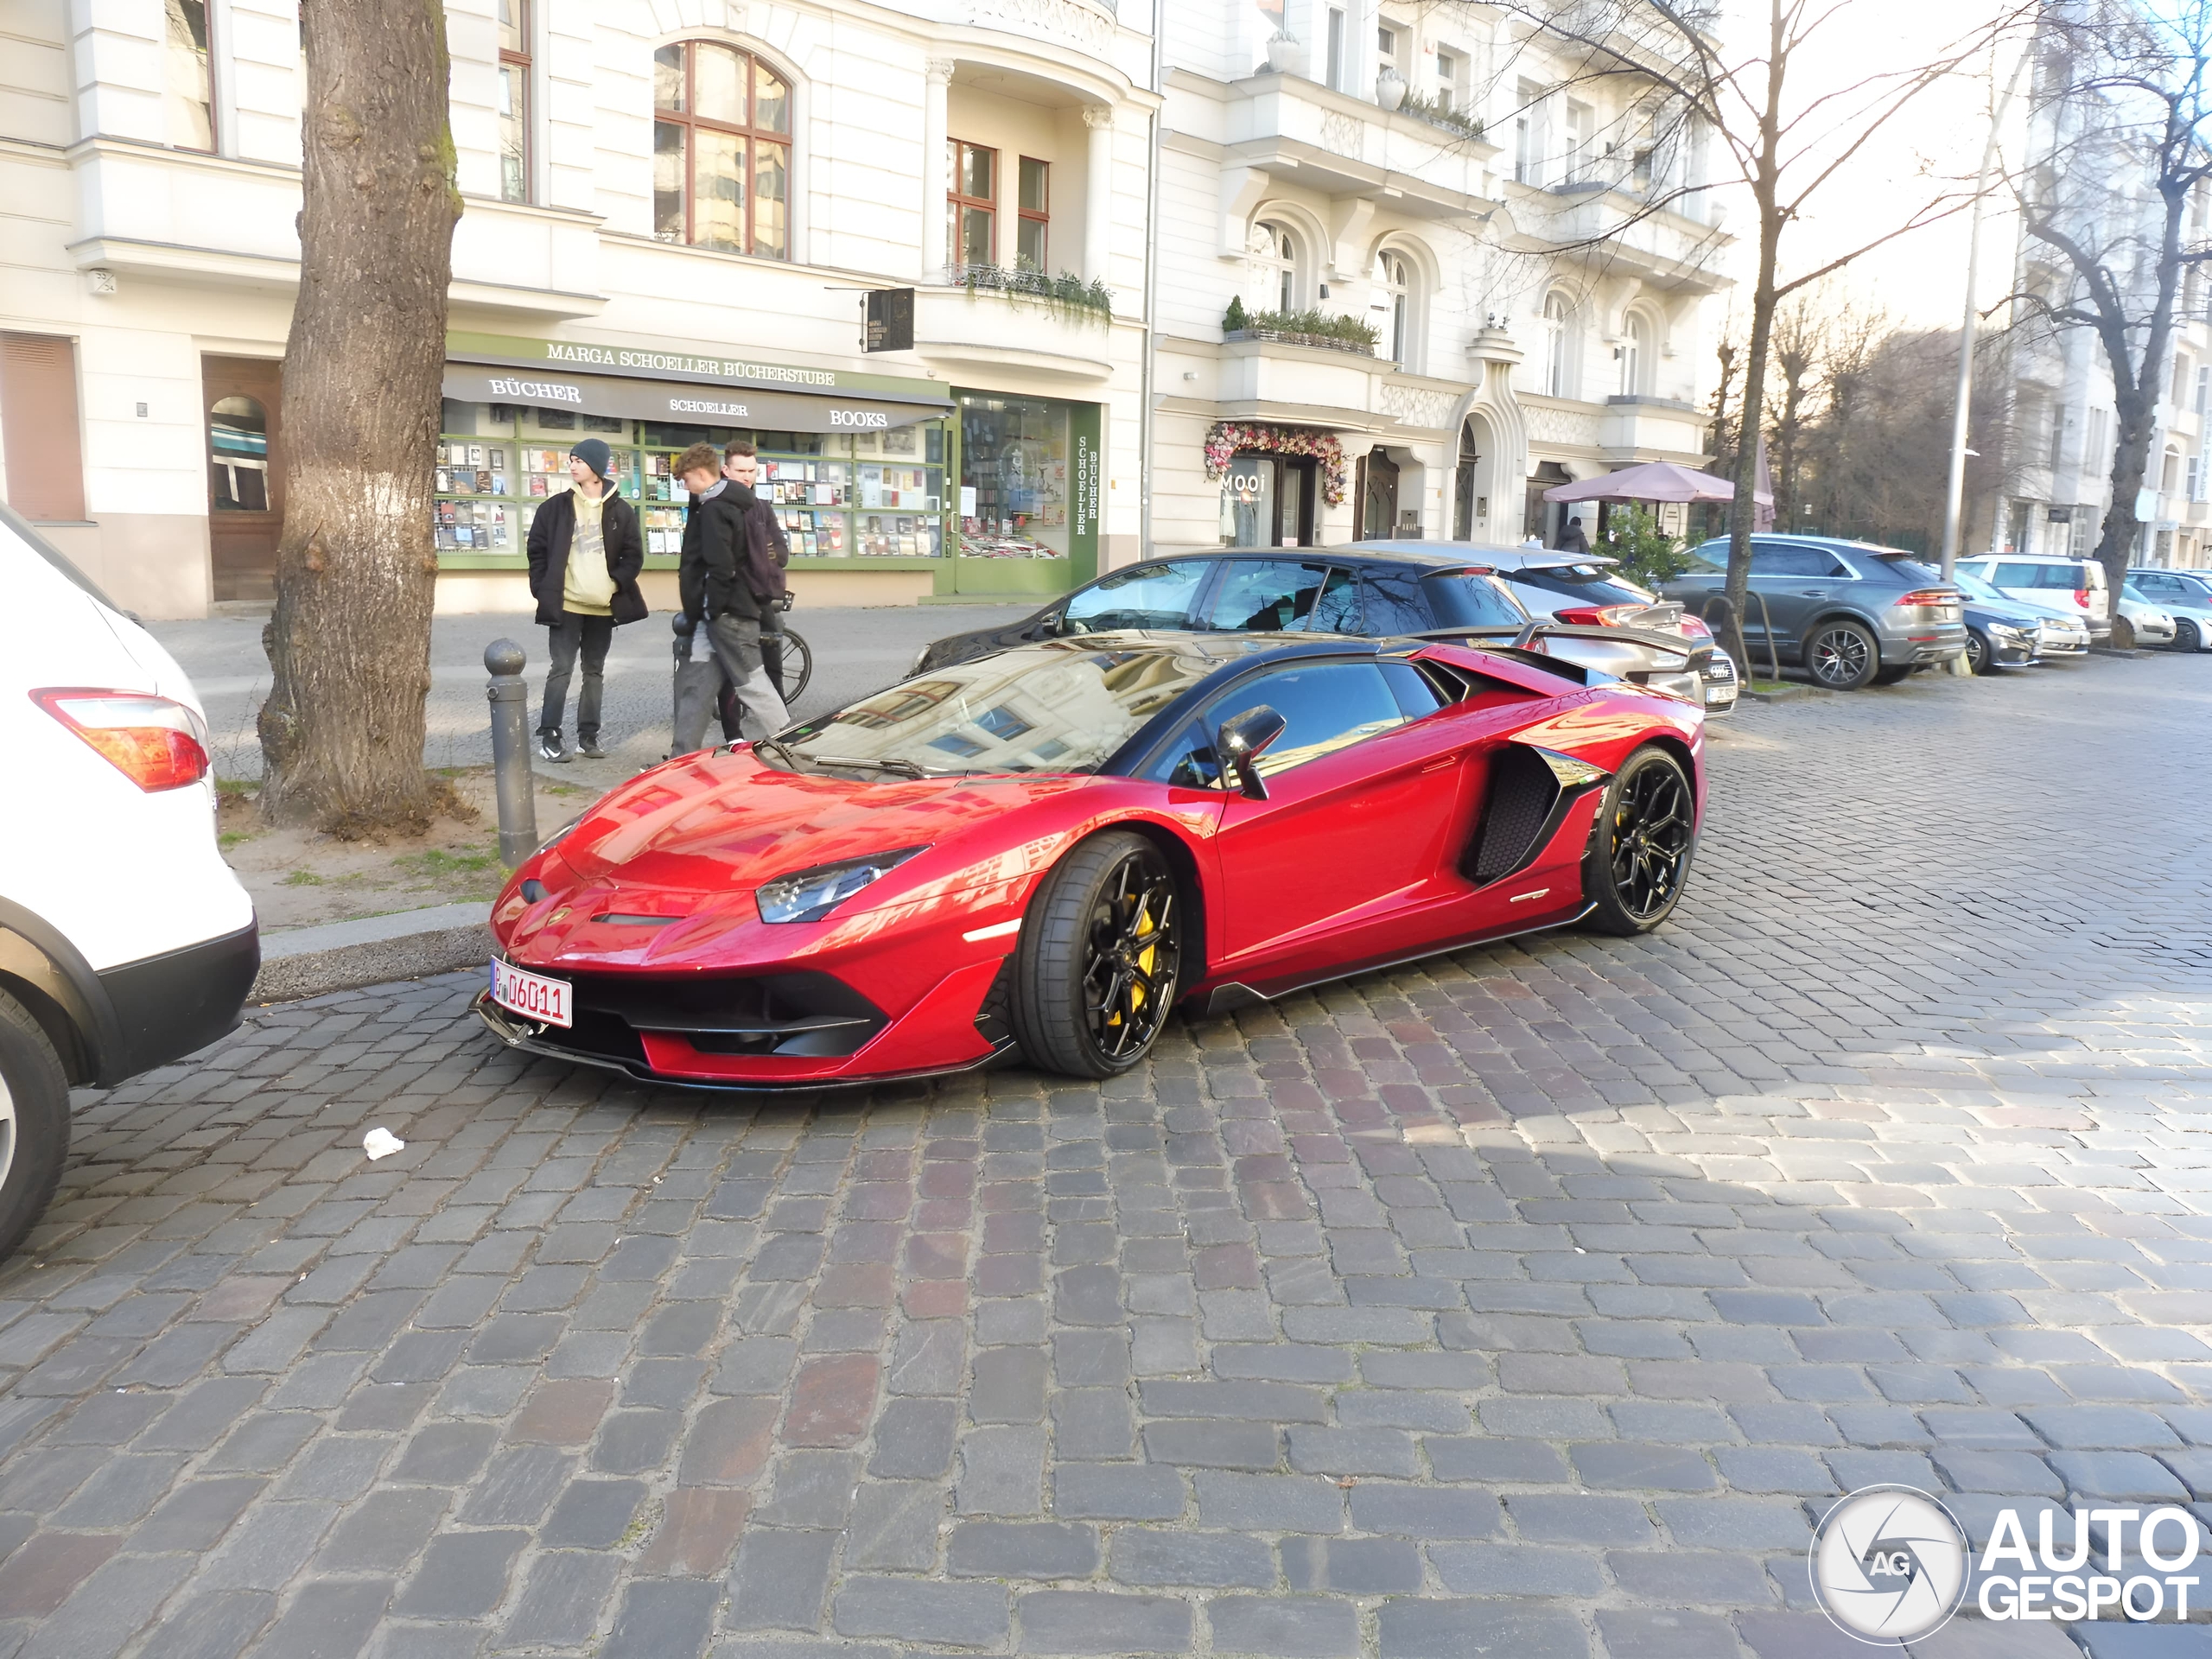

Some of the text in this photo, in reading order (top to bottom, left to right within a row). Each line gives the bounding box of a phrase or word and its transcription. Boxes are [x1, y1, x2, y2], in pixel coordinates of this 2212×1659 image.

[547, 344, 835, 385] MARGA SCHOELLER BÜCHERSTUBE
[488, 378, 582, 404] BÜCHER
[670, 399, 747, 416] SCHOELLER
[830, 410, 887, 427] BOOKS
[1077, 436, 1087, 535] SCHOELLER
[1089, 451, 1097, 518] BÜCHER
[509, 974, 563, 1020] 06011
